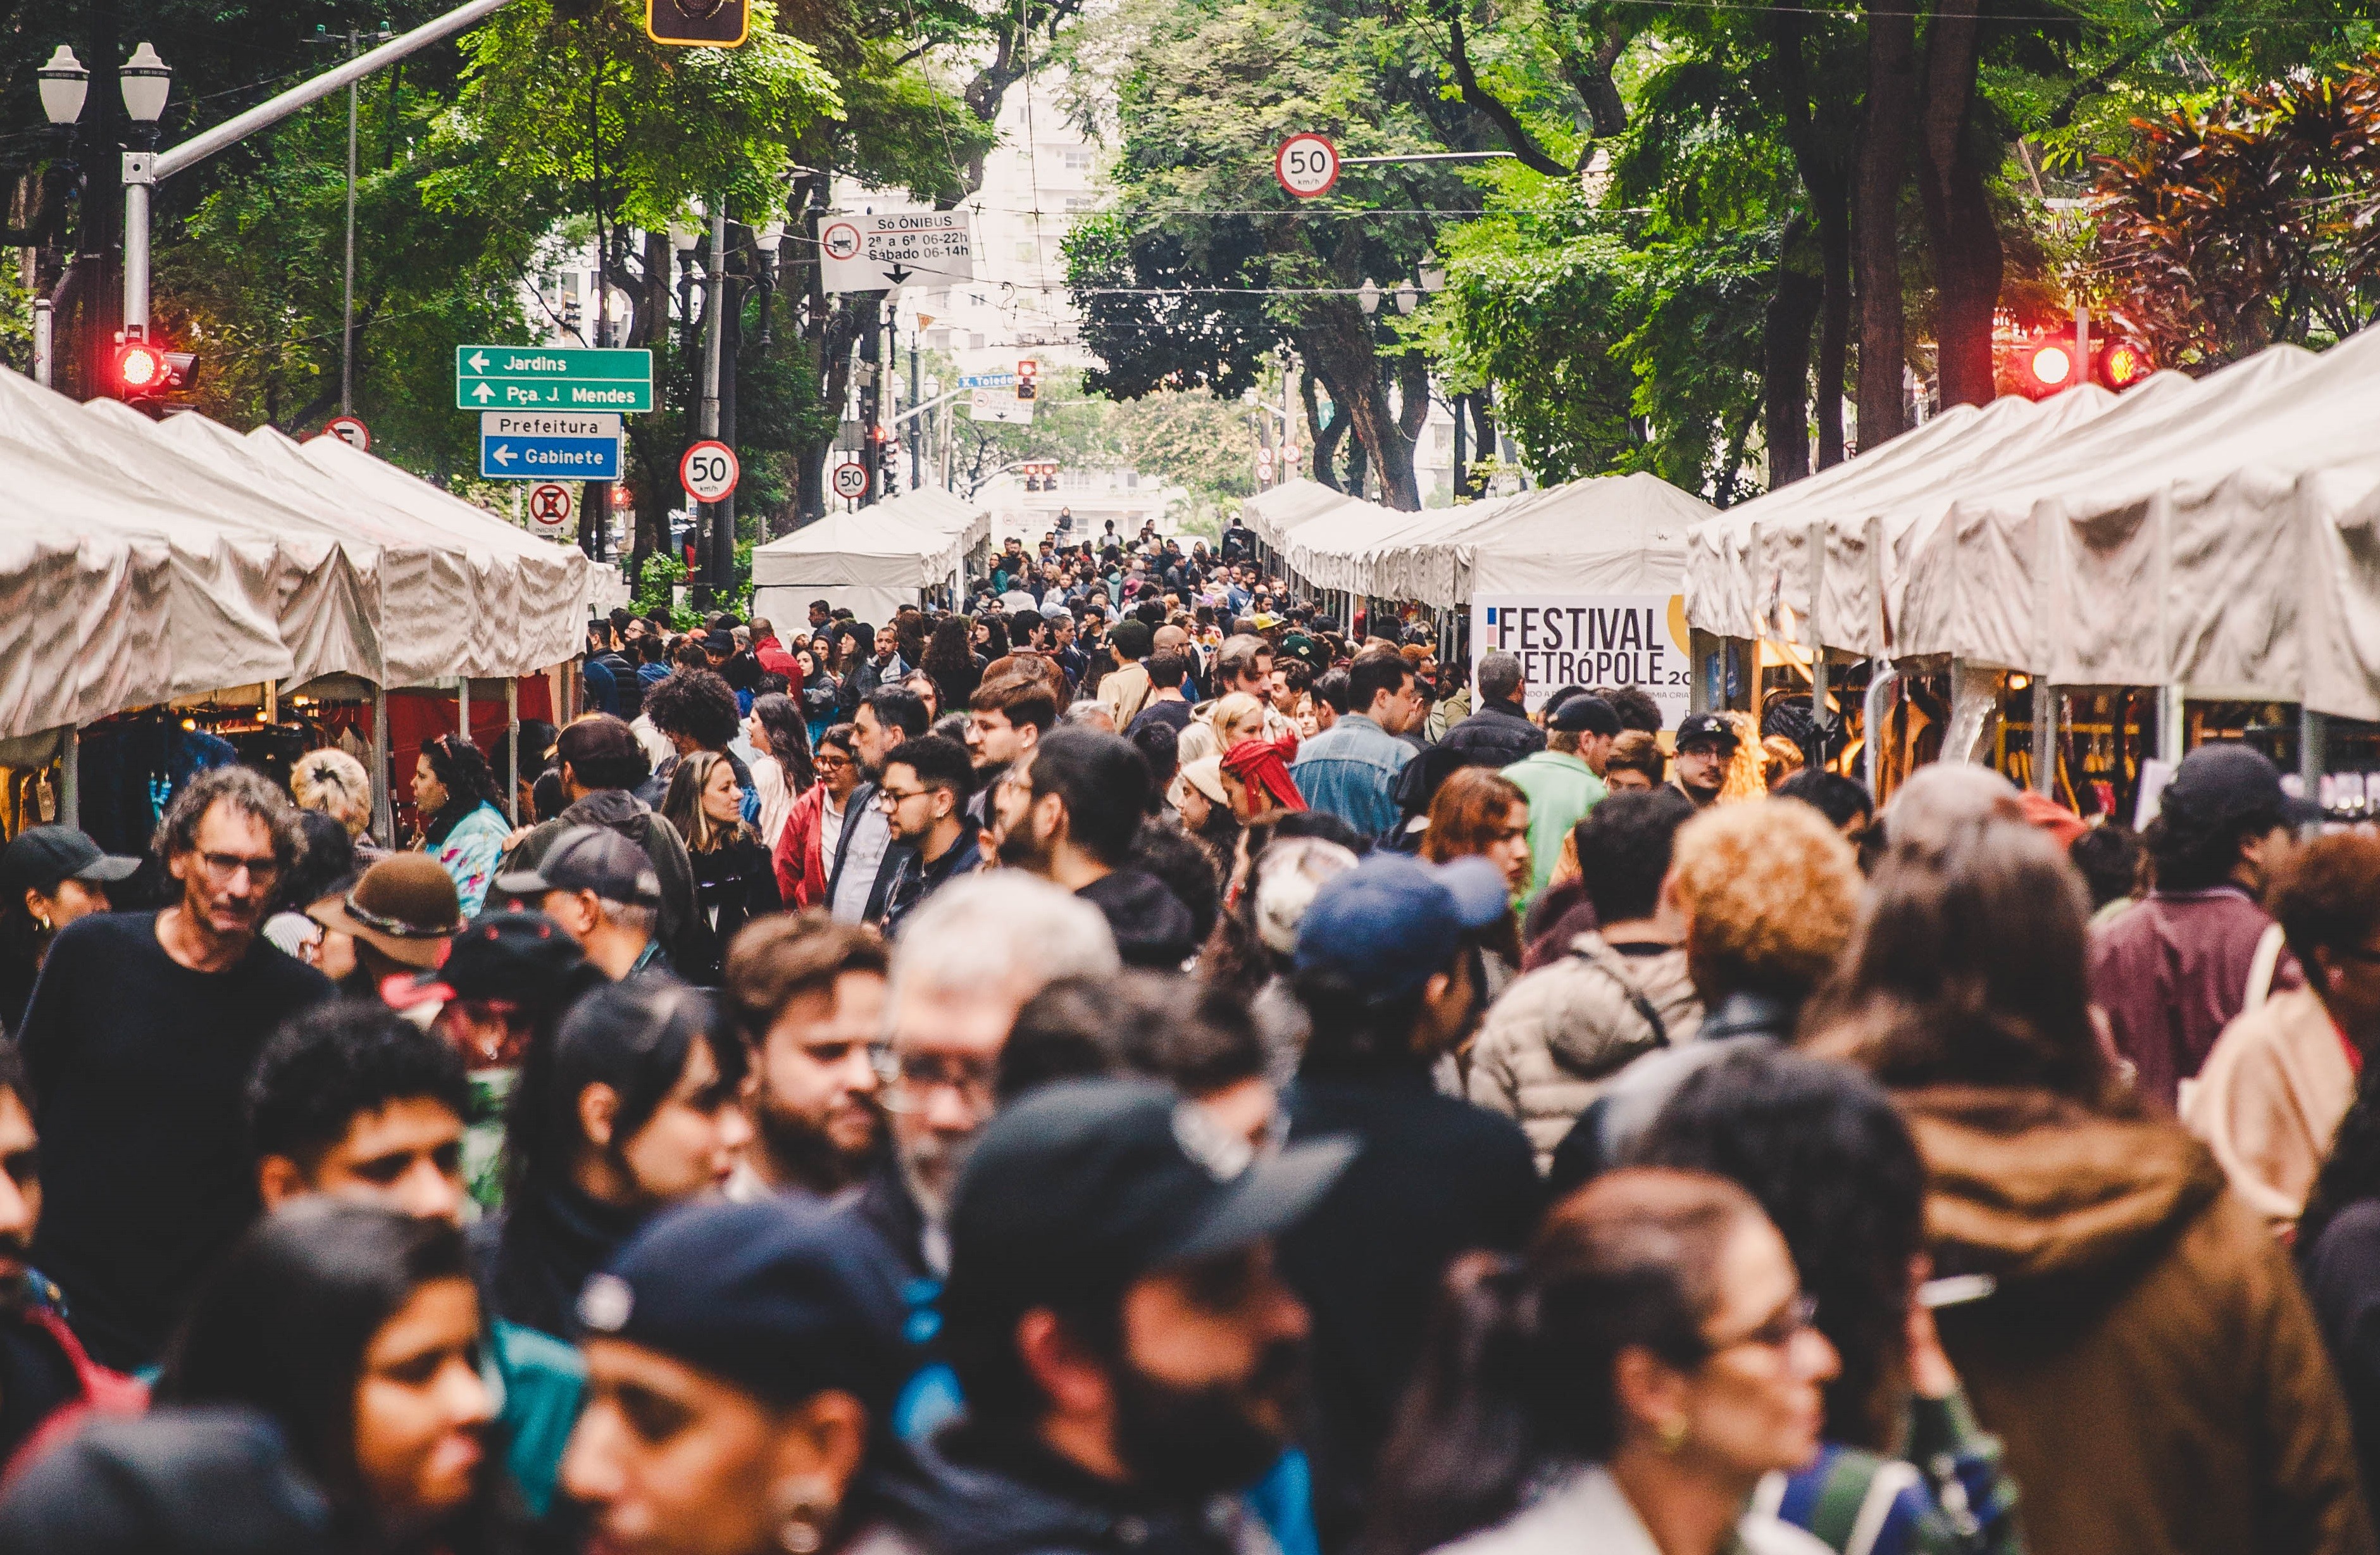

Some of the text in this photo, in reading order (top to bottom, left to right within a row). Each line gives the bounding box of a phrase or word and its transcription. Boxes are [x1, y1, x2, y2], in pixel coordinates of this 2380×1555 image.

[1291, 151, 1326, 174] 50
[878, 215, 952, 229] Só ÔNIBUS
[888, 238, 895, 246] a
[923, 232, 968, 245] 06-22h
[869, 245, 969, 261] Sábado 06-14h
[504, 356, 566, 372] Jardins
[977, 377, 1013, 386] Toledo
[507, 387, 635, 405] Pça. J. Mendes
[500, 418, 598, 434] Prefeitura
[525, 449, 603, 465] Gabinete
[692, 457, 726, 482] 50
[842, 471, 863, 487] 50
[1499, 607, 1664, 651] FESTIVAL
[1514, 651, 1664, 685] ETRóPOLE
